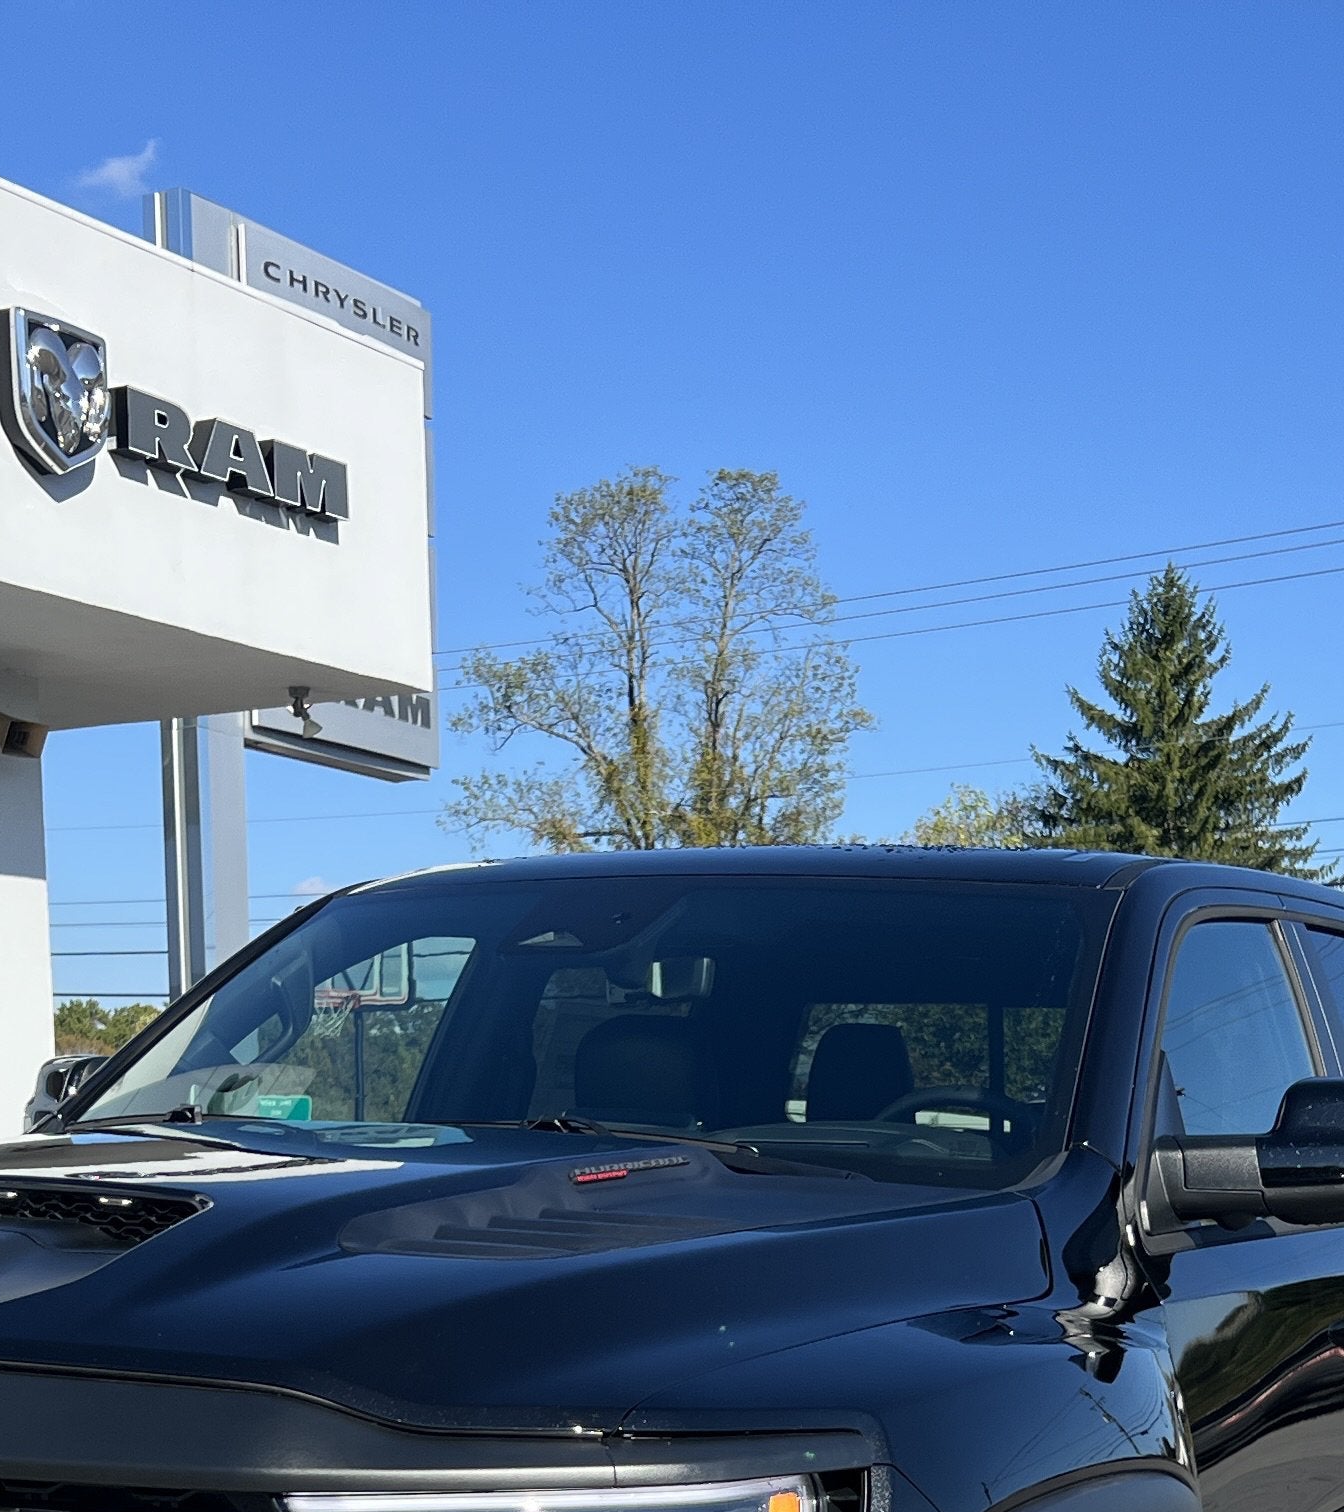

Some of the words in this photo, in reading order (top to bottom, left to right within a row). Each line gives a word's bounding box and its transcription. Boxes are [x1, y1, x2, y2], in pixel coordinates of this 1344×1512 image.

[263, 260, 420, 347] CHRYSLER
[121, 385, 350, 522] RAM
[338, 692, 431, 730] AM
